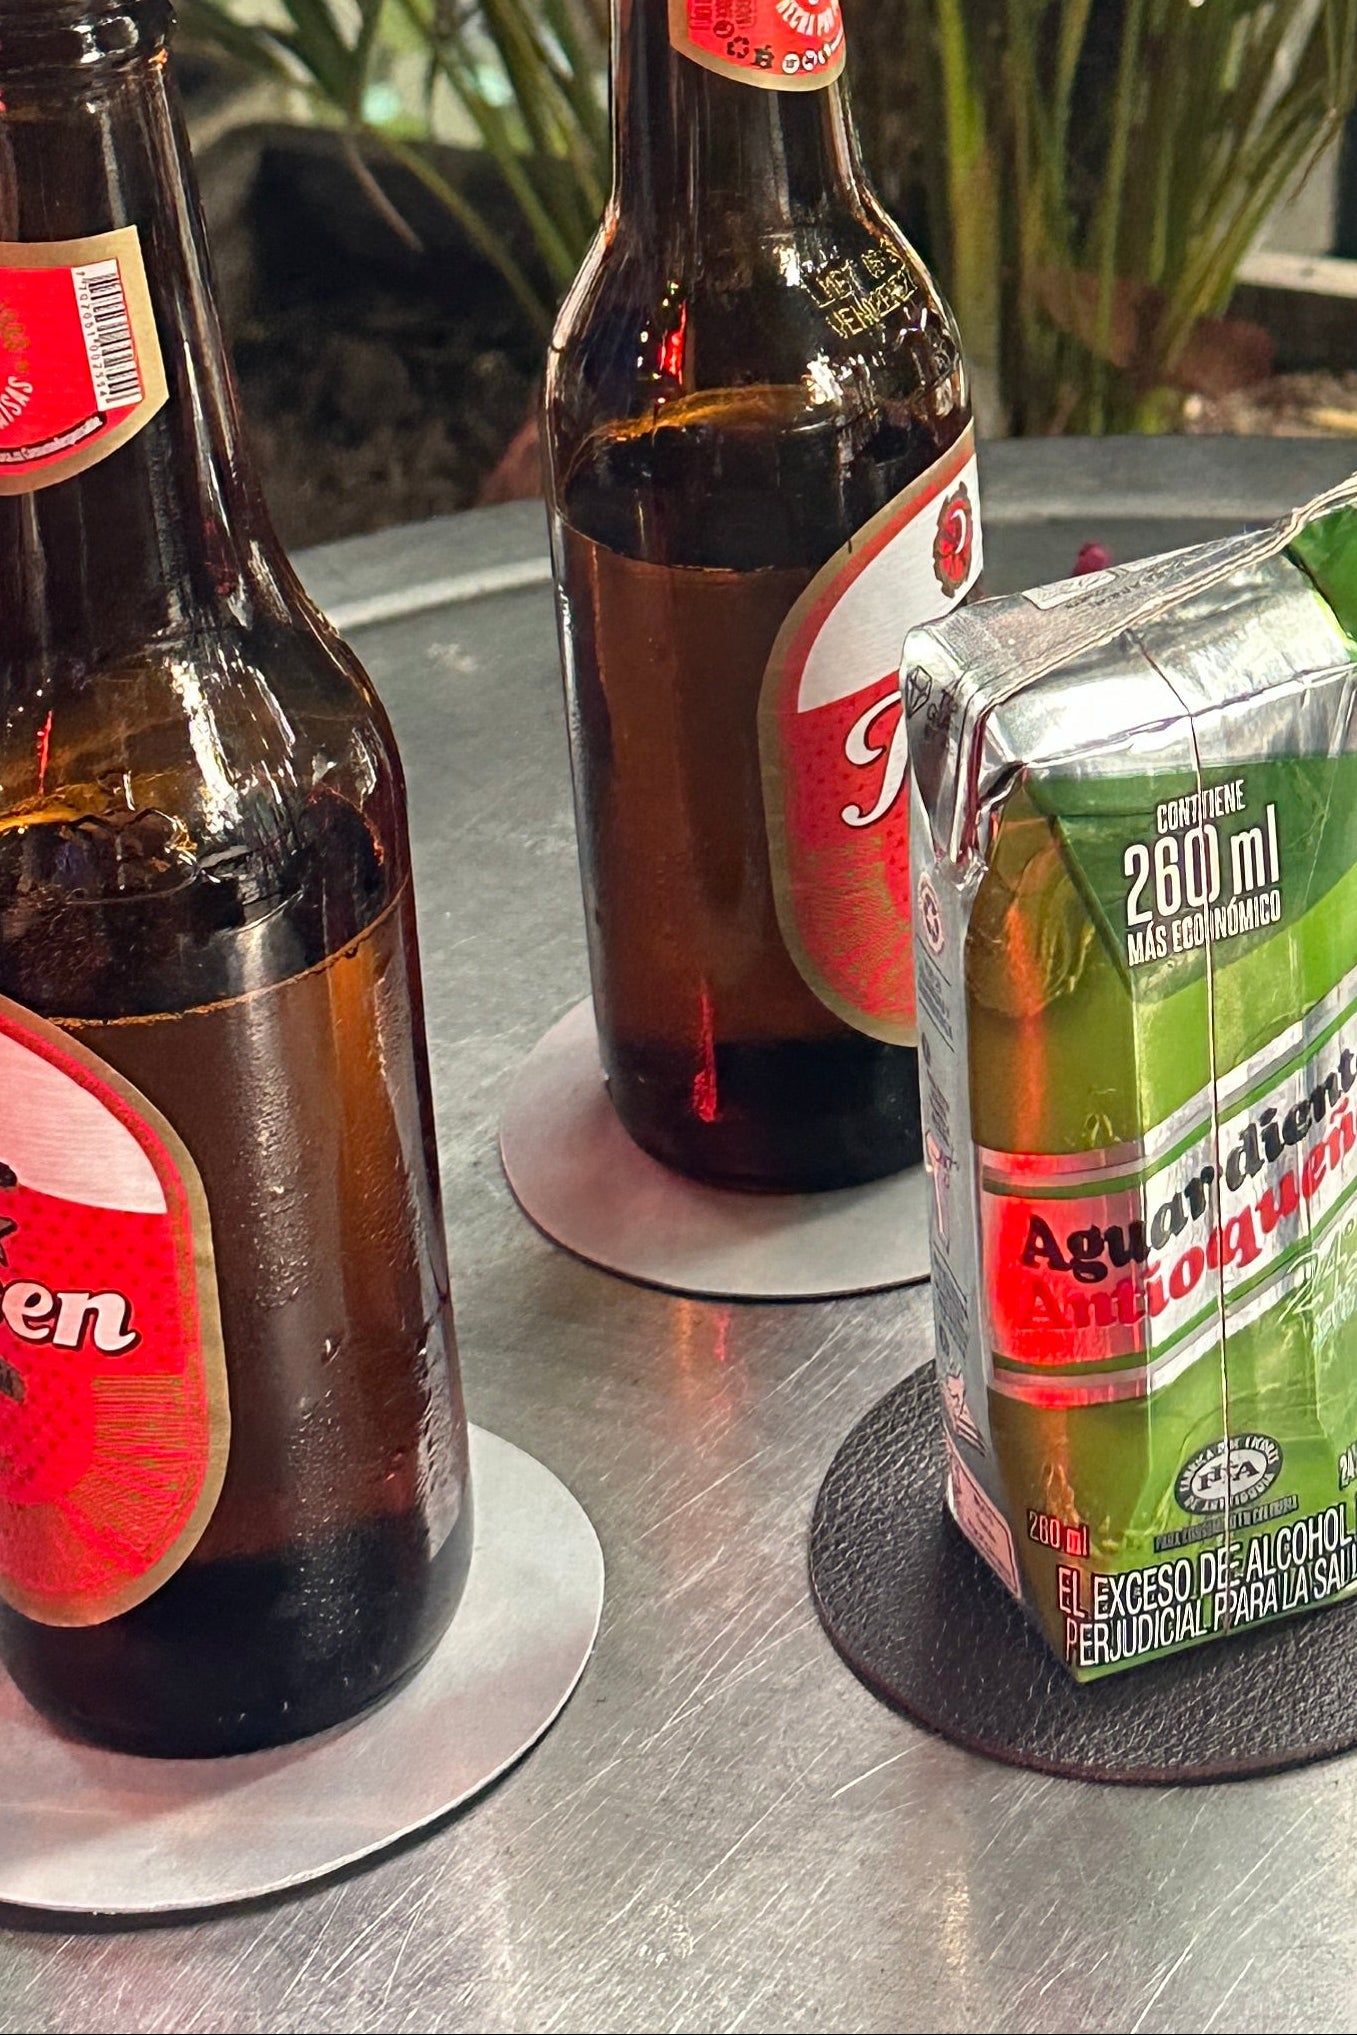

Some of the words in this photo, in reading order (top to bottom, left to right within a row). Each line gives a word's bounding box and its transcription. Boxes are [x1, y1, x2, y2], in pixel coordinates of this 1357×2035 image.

[1157, 779, 1246, 834] CONTIENE
[1124, 823, 1221, 926] 260
[1230, 804, 1279, 895] ml
[1127, 920, 1167, 967] MÁS
[1171, 889, 1282, 953] ECONÓMICO
[1019, 1096, 1357, 1330] Antioqueñ
[1020, 1047, 1357, 1283] Aguardient
[0, 1281, 137, 1352] en
[1058, 1566, 1086, 1618] EL
[1094, 1559, 1192, 1620] EXCESO
[1200, 1543, 1241, 1598] DE
[1246, 1504, 1352, 1583] ALCOHOL
[1066, 1598, 1208, 1666] PERJUDICIAL
[1213, 1577, 1278, 1632] PARA
[1281, 1565, 1309, 1611] LA
